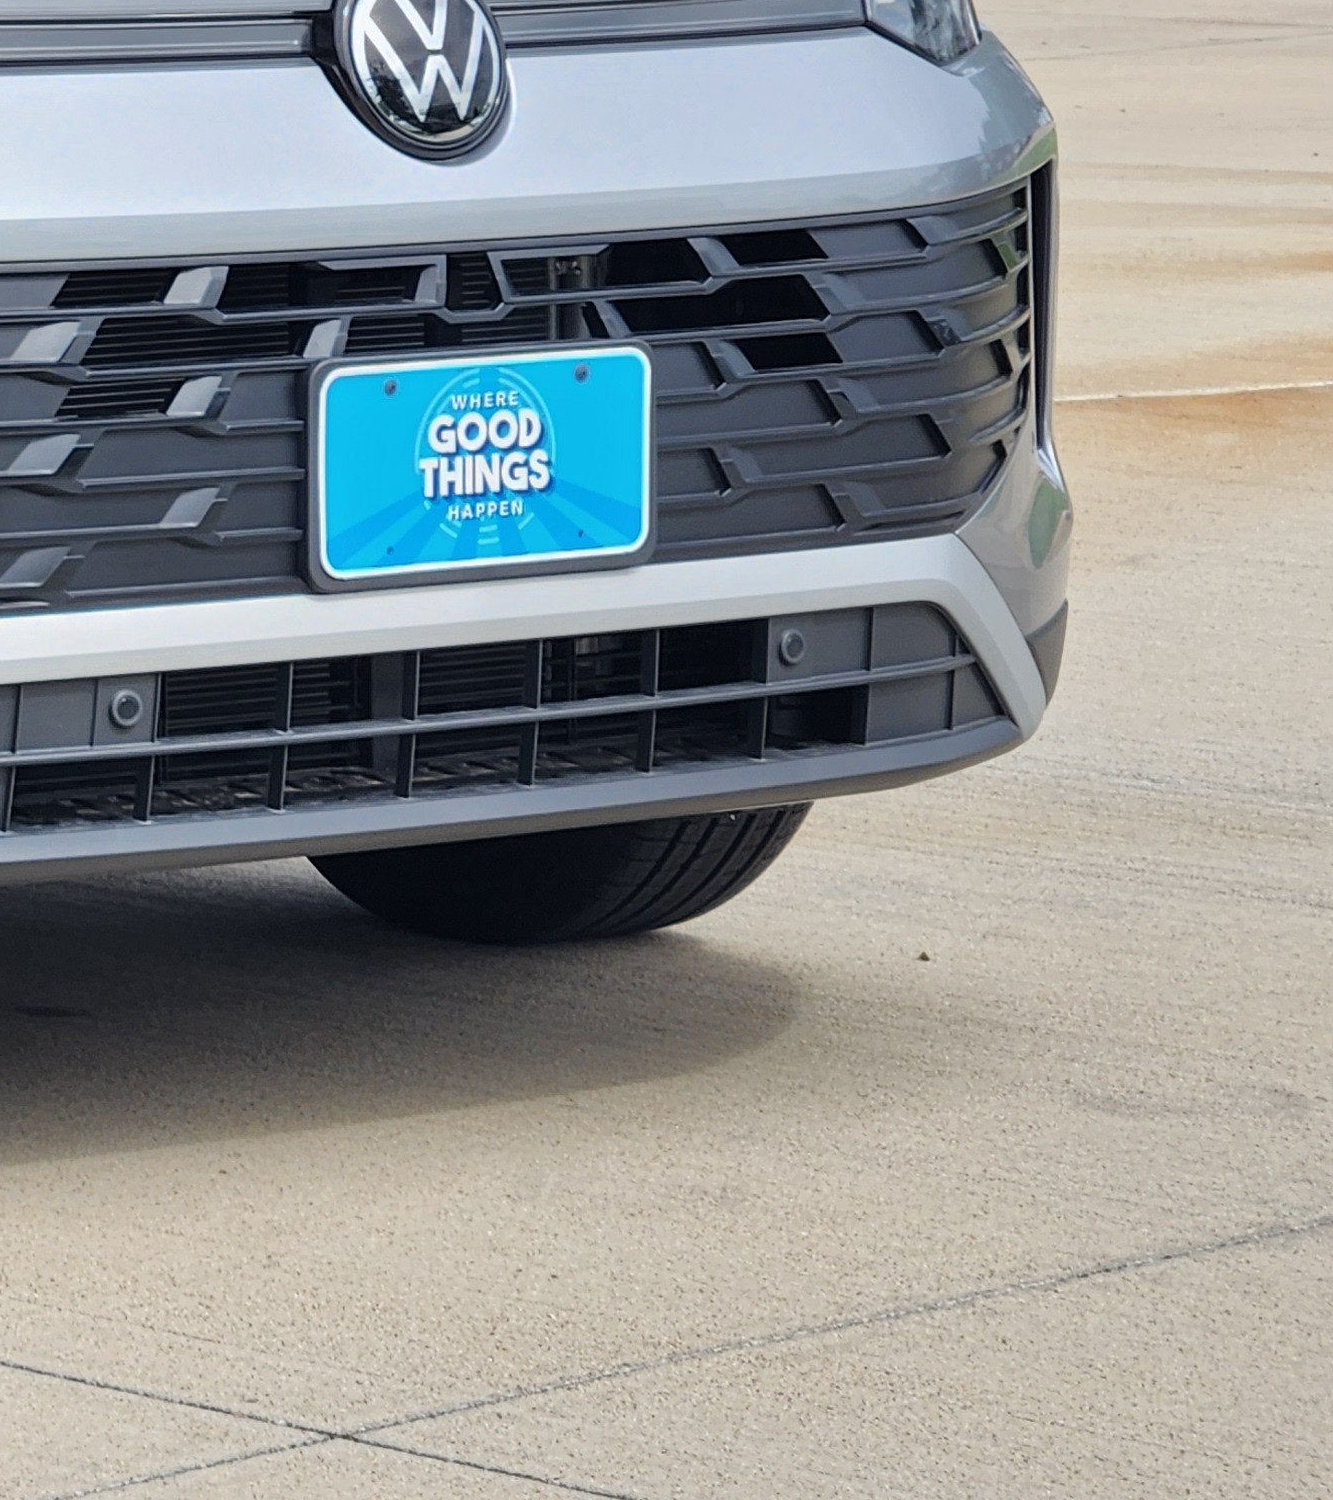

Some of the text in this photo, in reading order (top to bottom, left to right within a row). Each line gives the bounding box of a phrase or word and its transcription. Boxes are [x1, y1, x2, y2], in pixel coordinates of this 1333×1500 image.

[451, 391, 520, 410] WHERE
[427, 407, 543, 454] GOOD
[419, 449, 552, 498] THINGS
[447, 499, 524, 522] HAPPEN
